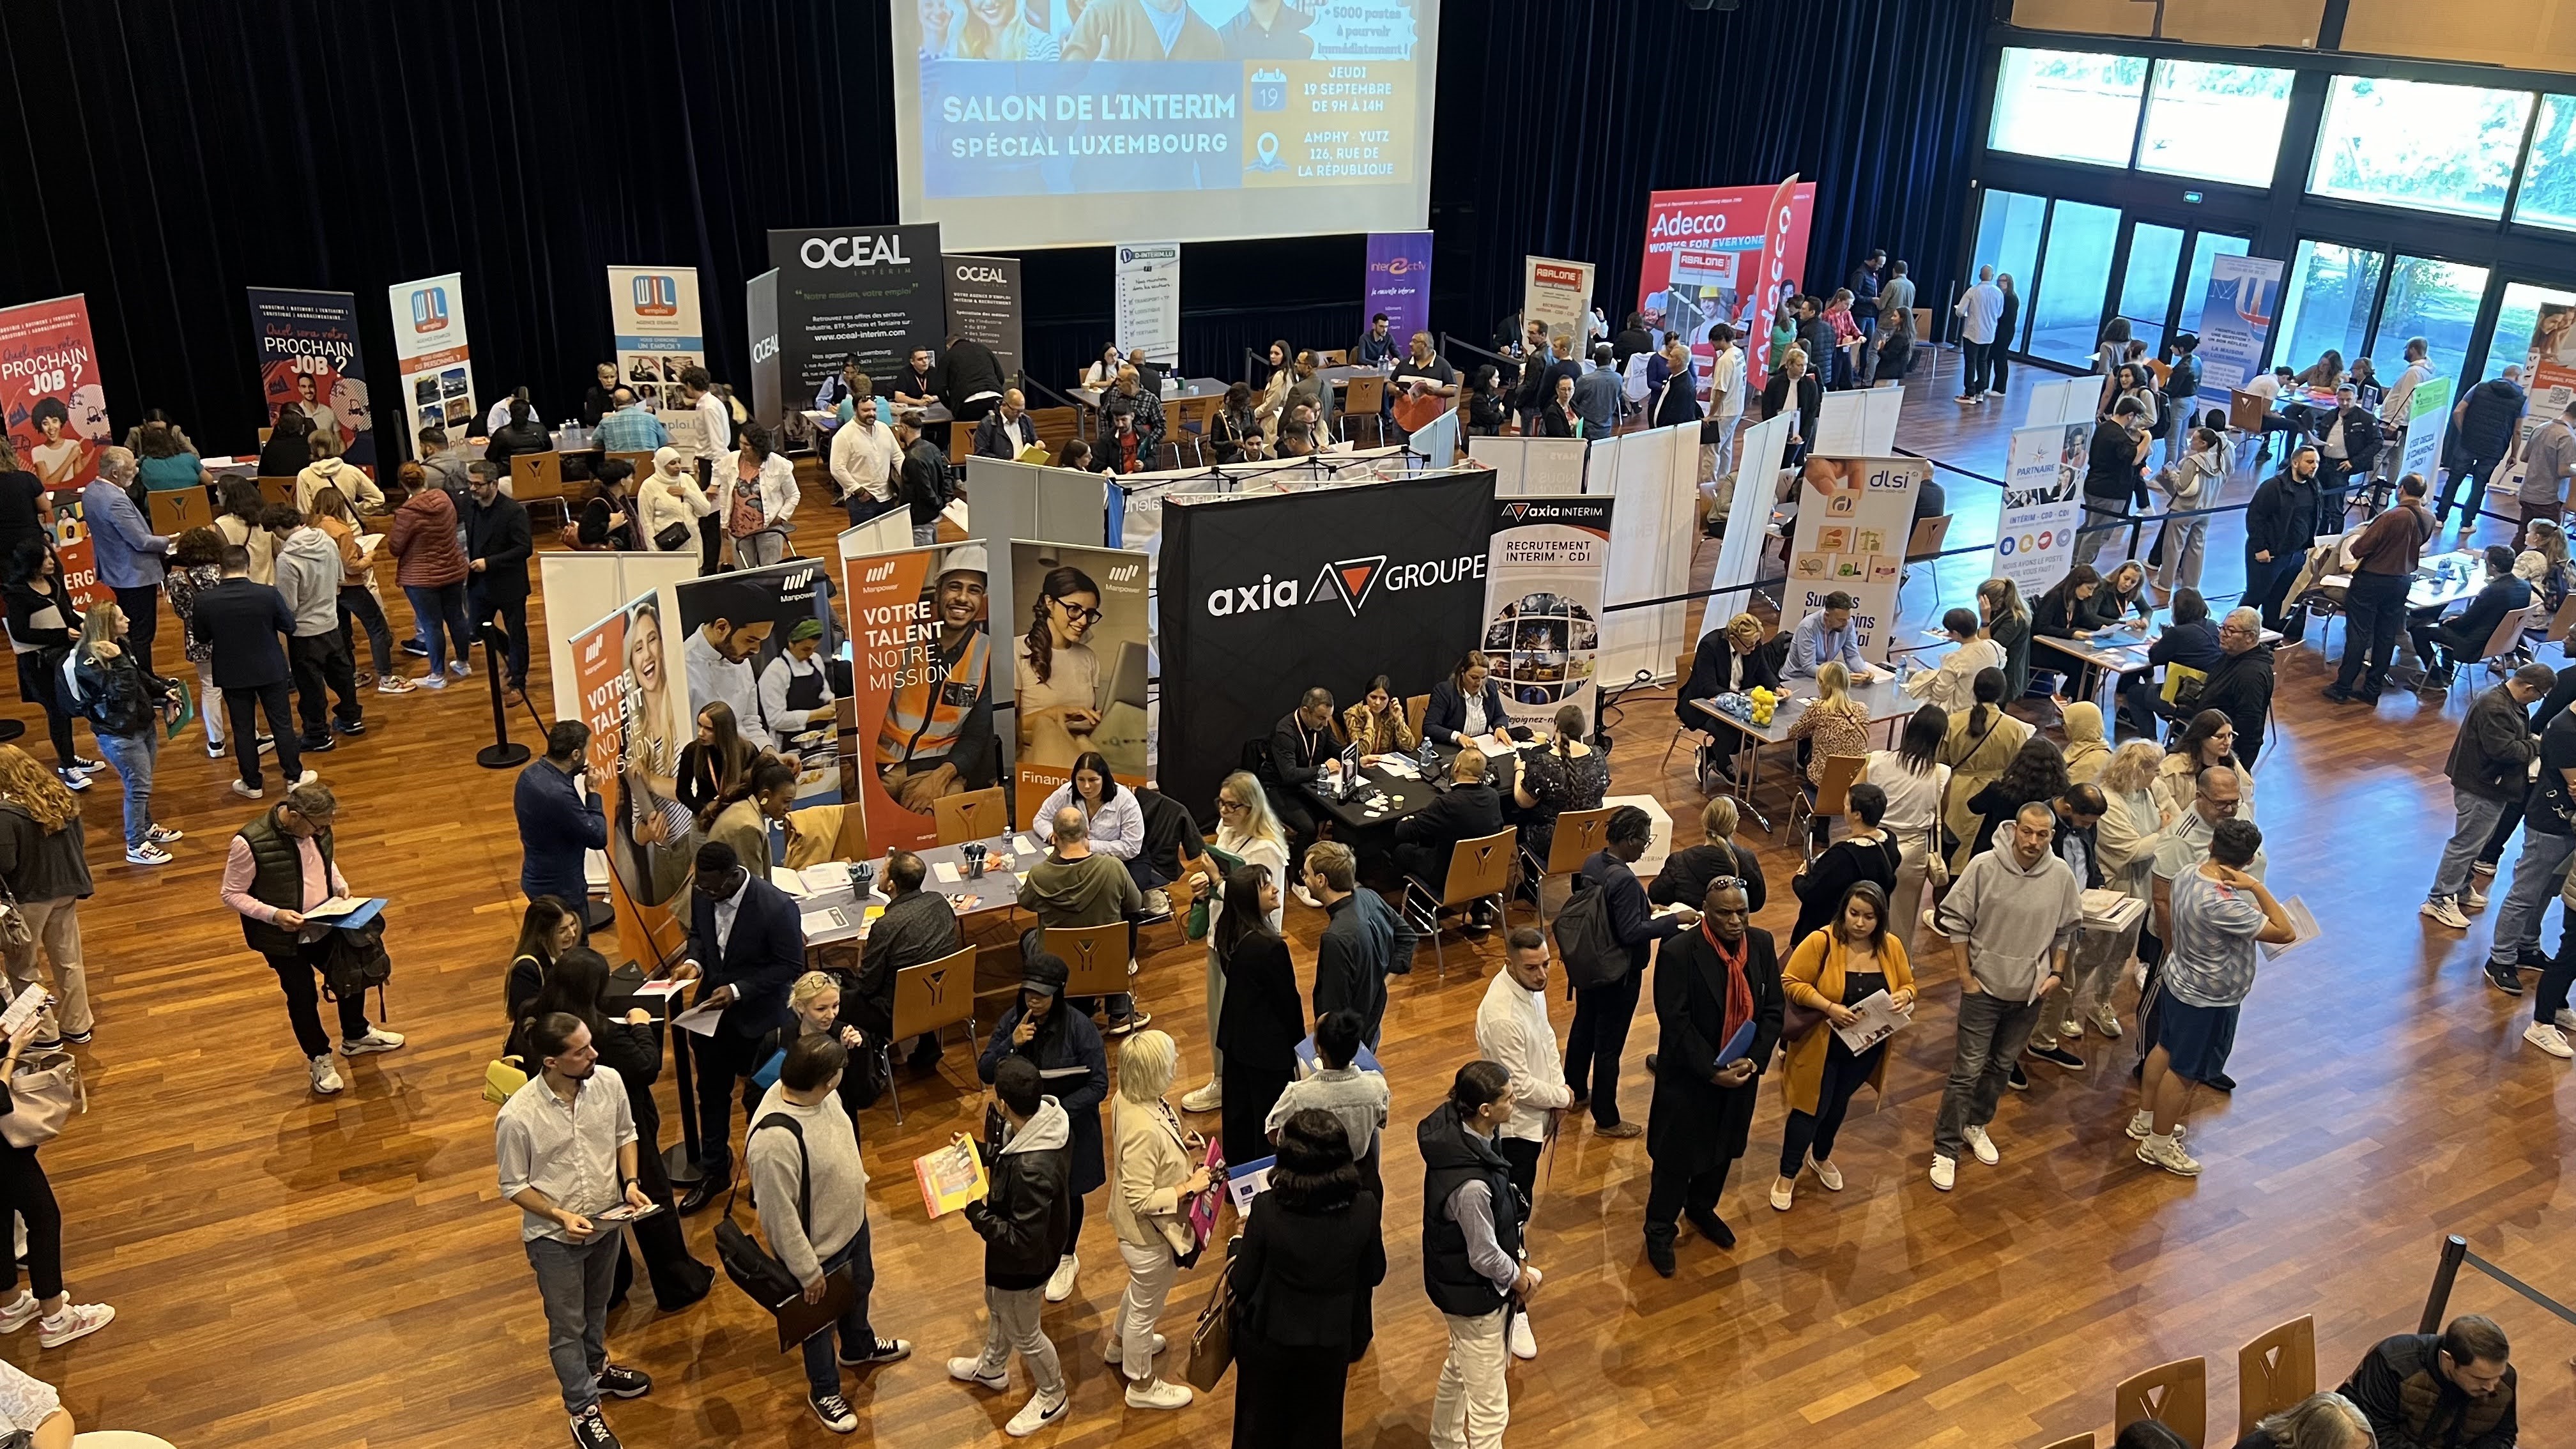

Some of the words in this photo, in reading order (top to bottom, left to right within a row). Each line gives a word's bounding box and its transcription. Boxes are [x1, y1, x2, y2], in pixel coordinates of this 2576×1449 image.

[1333, 6, 1363, 19] 5000
[1328, 66, 1367, 79] JEUDI
[1259, 88, 1278, 107] 19
[1304, 83, 1317, 95] 19
[1320, 83, 1392, 95] SEPTEMBRE
[943, 95, 1046, 123] SALON
[1056, 94, 1093, 121] DE
[1101, 93, 1236, 120] L'INTERIM
[1312, 100, 1328, 112] DE
[1331, 100, 1347, 112] 9H
[1362, 100, 1384, 112] 14H
[951, 132, 1059, 158] SPÉCIAL
[1068, 132, 1228, 156] LUXEMBOURG
[1303, 131, 1349, 143] AMPHY
[1359, 130, 1390, 142] YUTZ
[1310, 148, 1333, 161] 126,
[1337, 147, 1360, 159] RUE
[1364, 147, 1379, 158] DE
[1298, 165, 1314, 177] LA
[1316, 161, 1394, 176] RÉPUBLIQUE
[1651, 210, 1726, 238] Adecco
[1689, 239, 1710, 249] FOR
[1712, 235, 1765, 247] EVERYONE
[801, 234, 911, 269] OCEAL
[1681, 255, 1725, 267] ABALONE
[956, 266, 1008, 284] OCEAL
[1536, 268, 1576, 281] ABALONE
[815, 328, 906, 341] www.oceal-interim.com
[264, 336, 355, 358] PROCHAIN
[753, 334, 780, 364] OCEAL
[1, 346, 88, 381] PROCHAIN
[290, 354, 329, 376] JOB
[28, 369, 66, 396] JOB
[2016, 463, 2055, 477] PARTNAIRE
[1869, 470, 1910, 489] dlsi
[1529, 505, 1560, 517] axia
[1561, 507, 1604, 517] INTERIM
[2009, 512, 2036, 525] INTÉRIM
[1506, 541, 1591, 551] RECRUTEMENT
[1506, 552, 1555, 562] INTERIM
[1568, 552, 1591, 562] CDI
[862, 583, 900, 594] Manpower
[1105, 583, 1141, 594] Manpower
[1208, 573, 1299, 618] axia
[1384, 553, 1487, 592] GROUPE
[780, 590, 818, 603] Manpower
[863, 601, 932, 626] VOTRE
[864, 620, 946, 648] TALENT
[870, 663, 953, 692] MISSION
[587, 668, 633, 712] VOTRE
[591, 687, 643, 736] TALENT
[595, 714, 642, 762] NOTRE
[594, 732, 656, 786] MISSION
